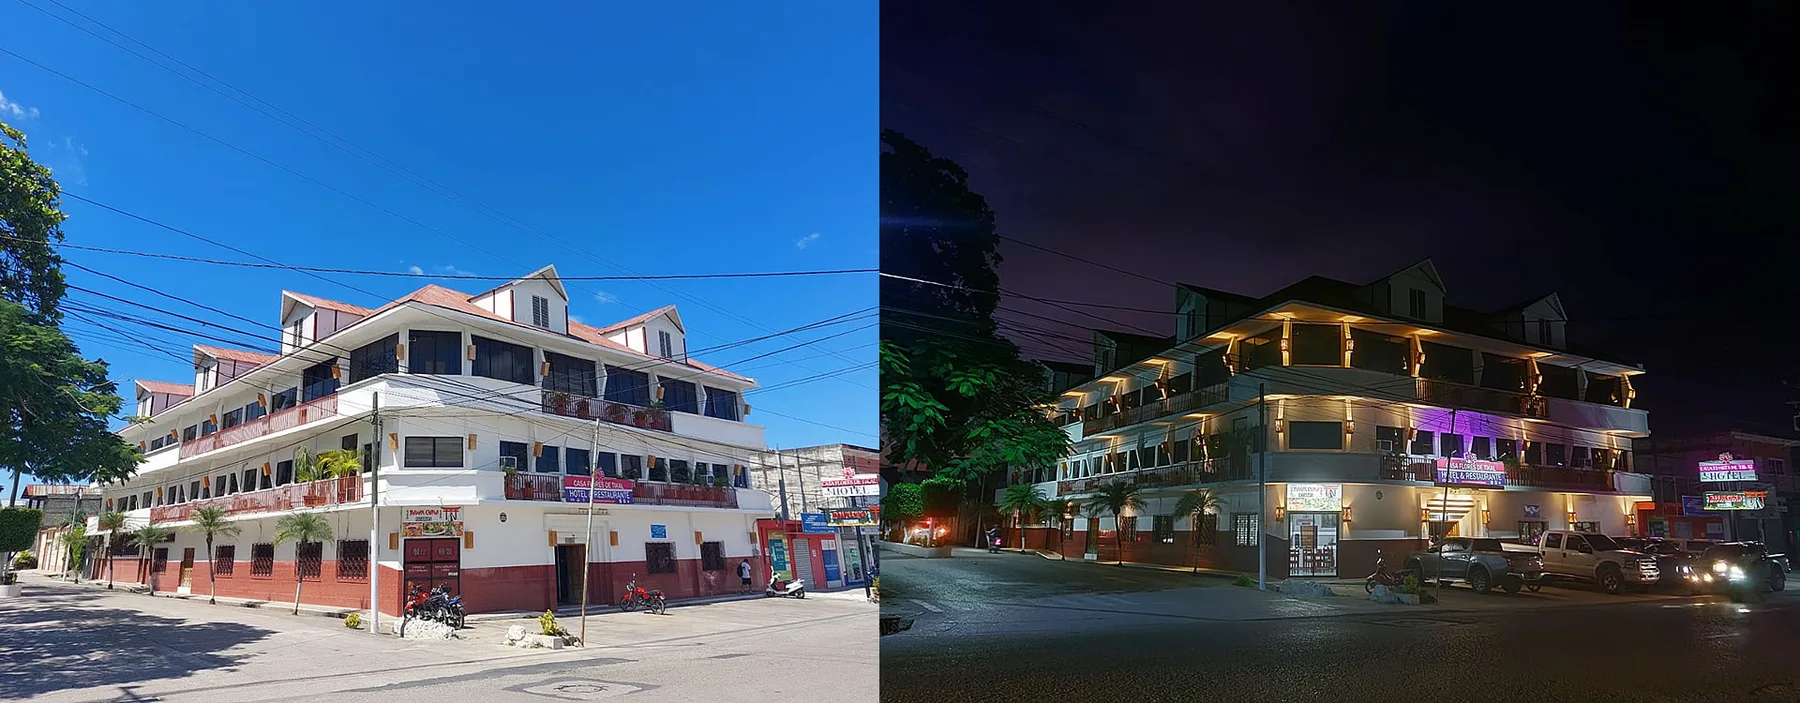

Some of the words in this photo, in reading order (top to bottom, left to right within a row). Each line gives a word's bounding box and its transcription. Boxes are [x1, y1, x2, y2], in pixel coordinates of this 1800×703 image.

[1466, 473, 1502, 481] RESTAURANTE
[1711, 472, 1745, 480] HOTEL
[569, 489, 588, 498] HOTEL
[594, 491, 630, 500] RESTAURANTE
[832, 486, 870, 496] HOTEL
